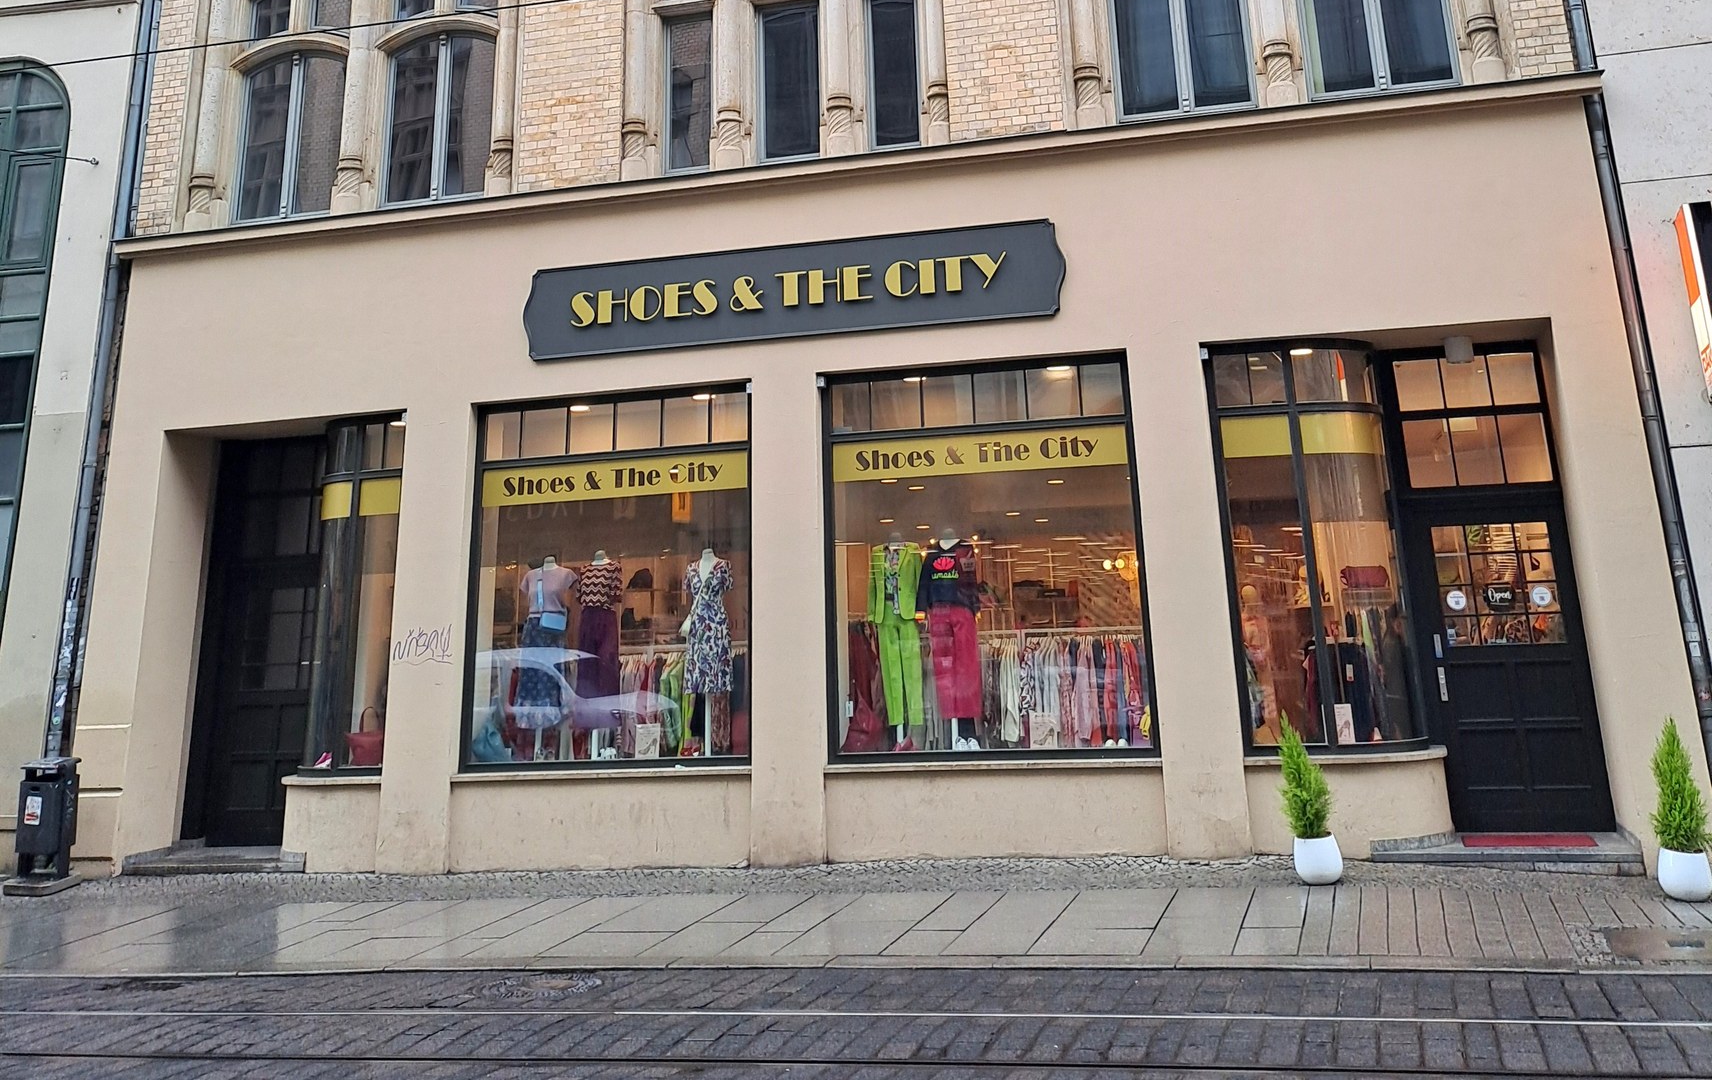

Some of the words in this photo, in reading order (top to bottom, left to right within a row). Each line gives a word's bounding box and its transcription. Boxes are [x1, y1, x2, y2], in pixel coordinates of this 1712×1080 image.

[570, 279, 718, 328] SHOES
[729, 275, 763, 312] &
[774, 265, 874, 308] THE
[883, 251, 1007, 297] CITY
[855, 448, 936, 471] Shoes
[944, 445, 965, 466] &
[973, 441, 1031, 463] The
[1039, 435, 1099, 460] City
[503, 475, 575, 497] Shoes
[583, 470, 601, 491] &
[610, 467, 661, 488] The
[669, 461, 723, 484] City
[1488, 587, 1512, 602] Open
